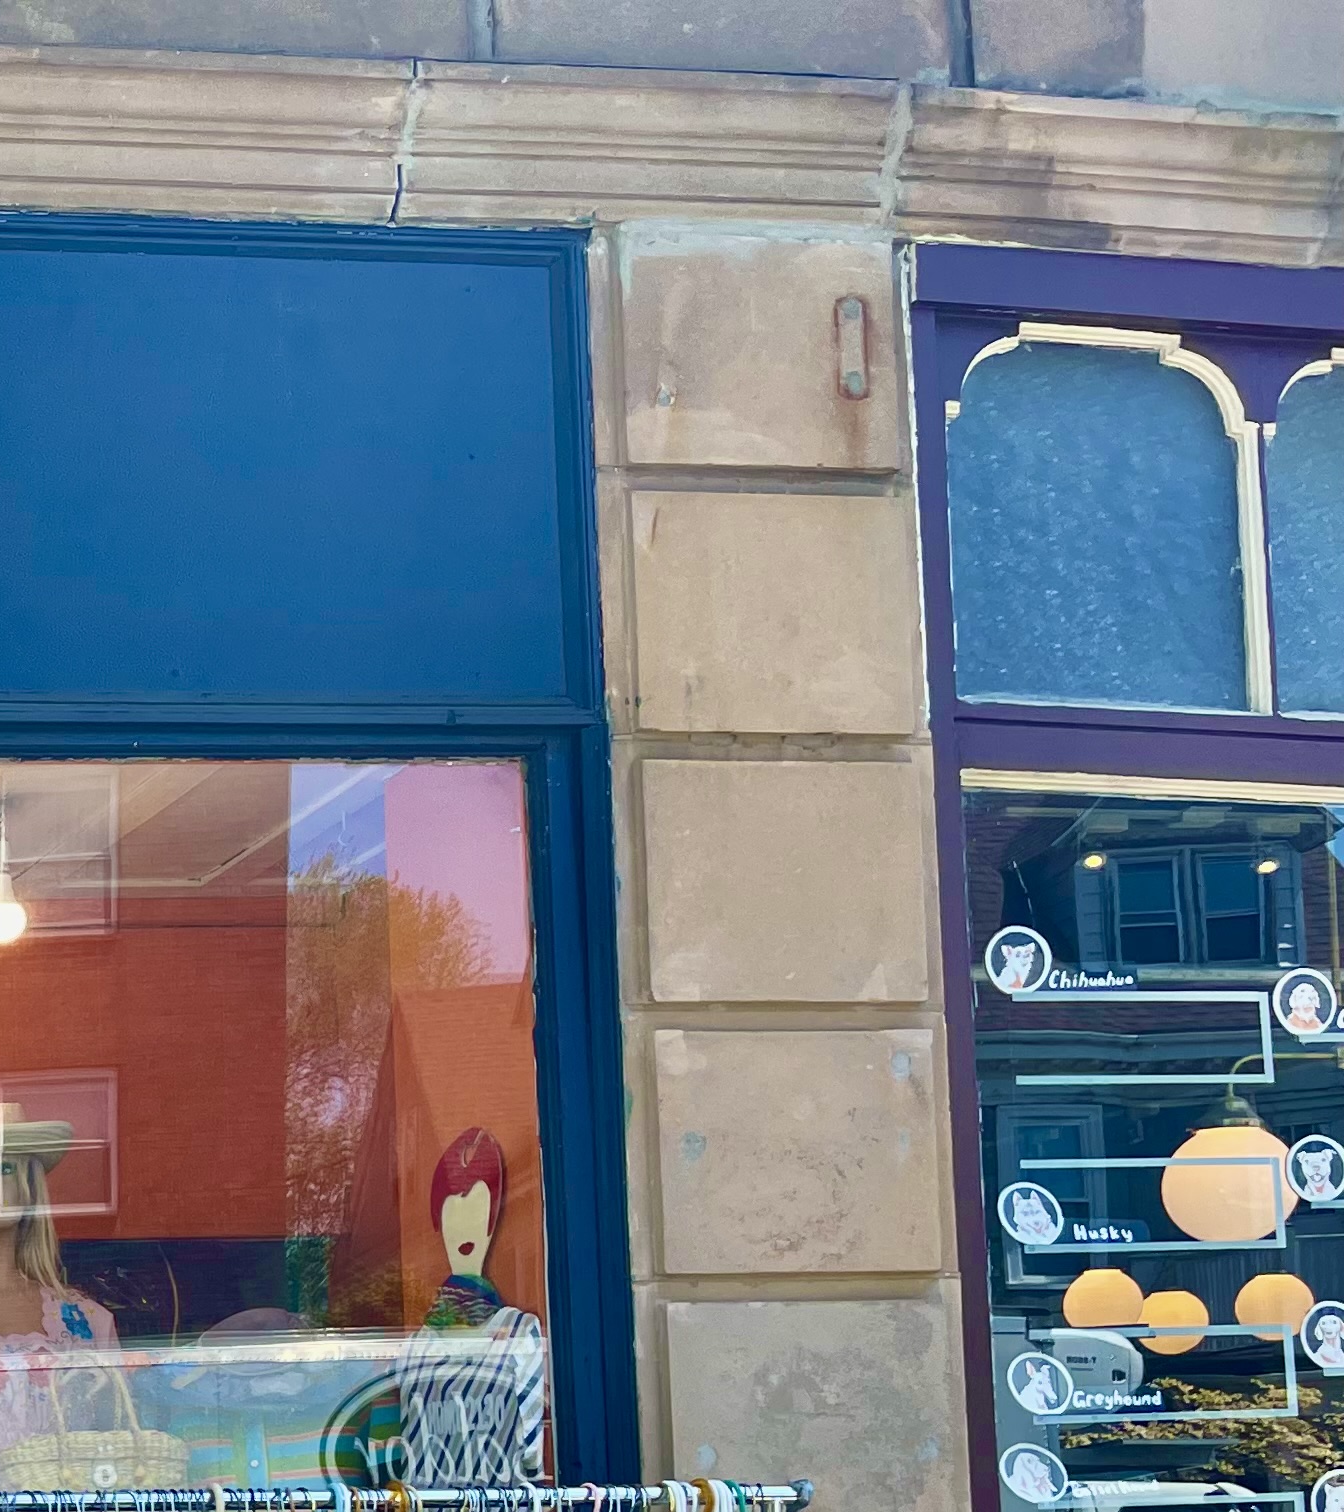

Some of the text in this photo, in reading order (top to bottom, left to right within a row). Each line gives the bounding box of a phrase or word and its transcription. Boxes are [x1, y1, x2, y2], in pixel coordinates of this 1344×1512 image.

[1048, 969, 1134, 989] Chihuahua
[1073, 1223, 1134, 1243] Husky
[1072, 1390, 1162, 1410] Greyhound
